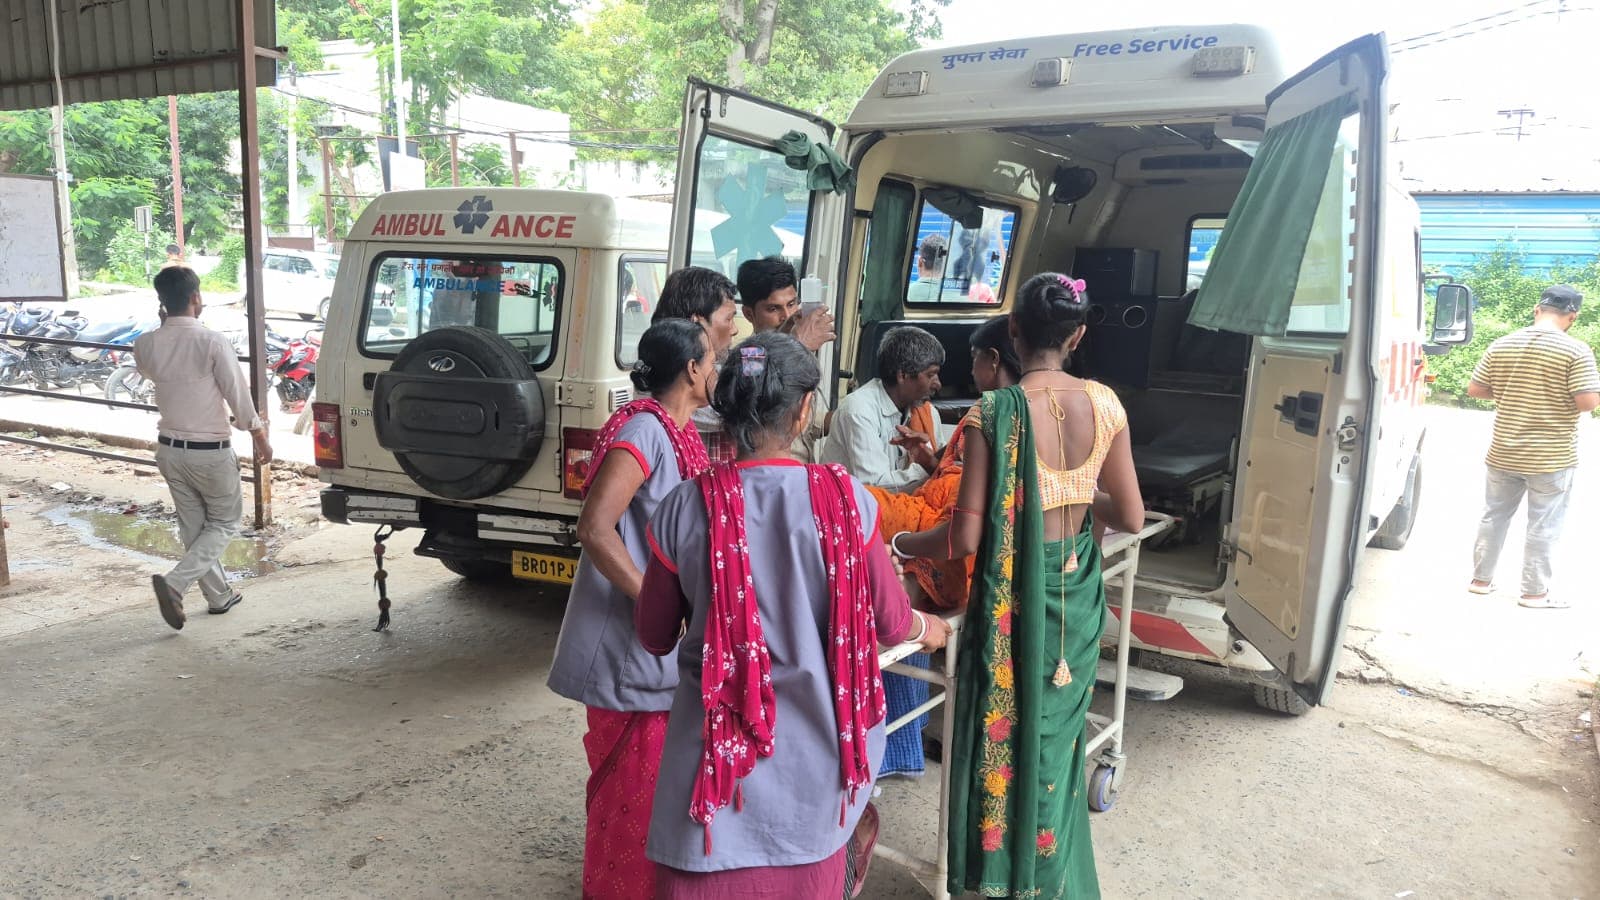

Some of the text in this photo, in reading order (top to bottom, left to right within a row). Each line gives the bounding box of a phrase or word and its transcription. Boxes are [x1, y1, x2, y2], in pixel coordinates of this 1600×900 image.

[989, 46, 1029, 61] सेवा
[1073, 33, 1218, 58] Free Service
[371, 213, 577, 239] AMBUL ANCE
[413, 277, 506, 293] AMBULANCE
[350, 407, 374, 417] Mah
[521, 556, 577, 579] BR01PJ
